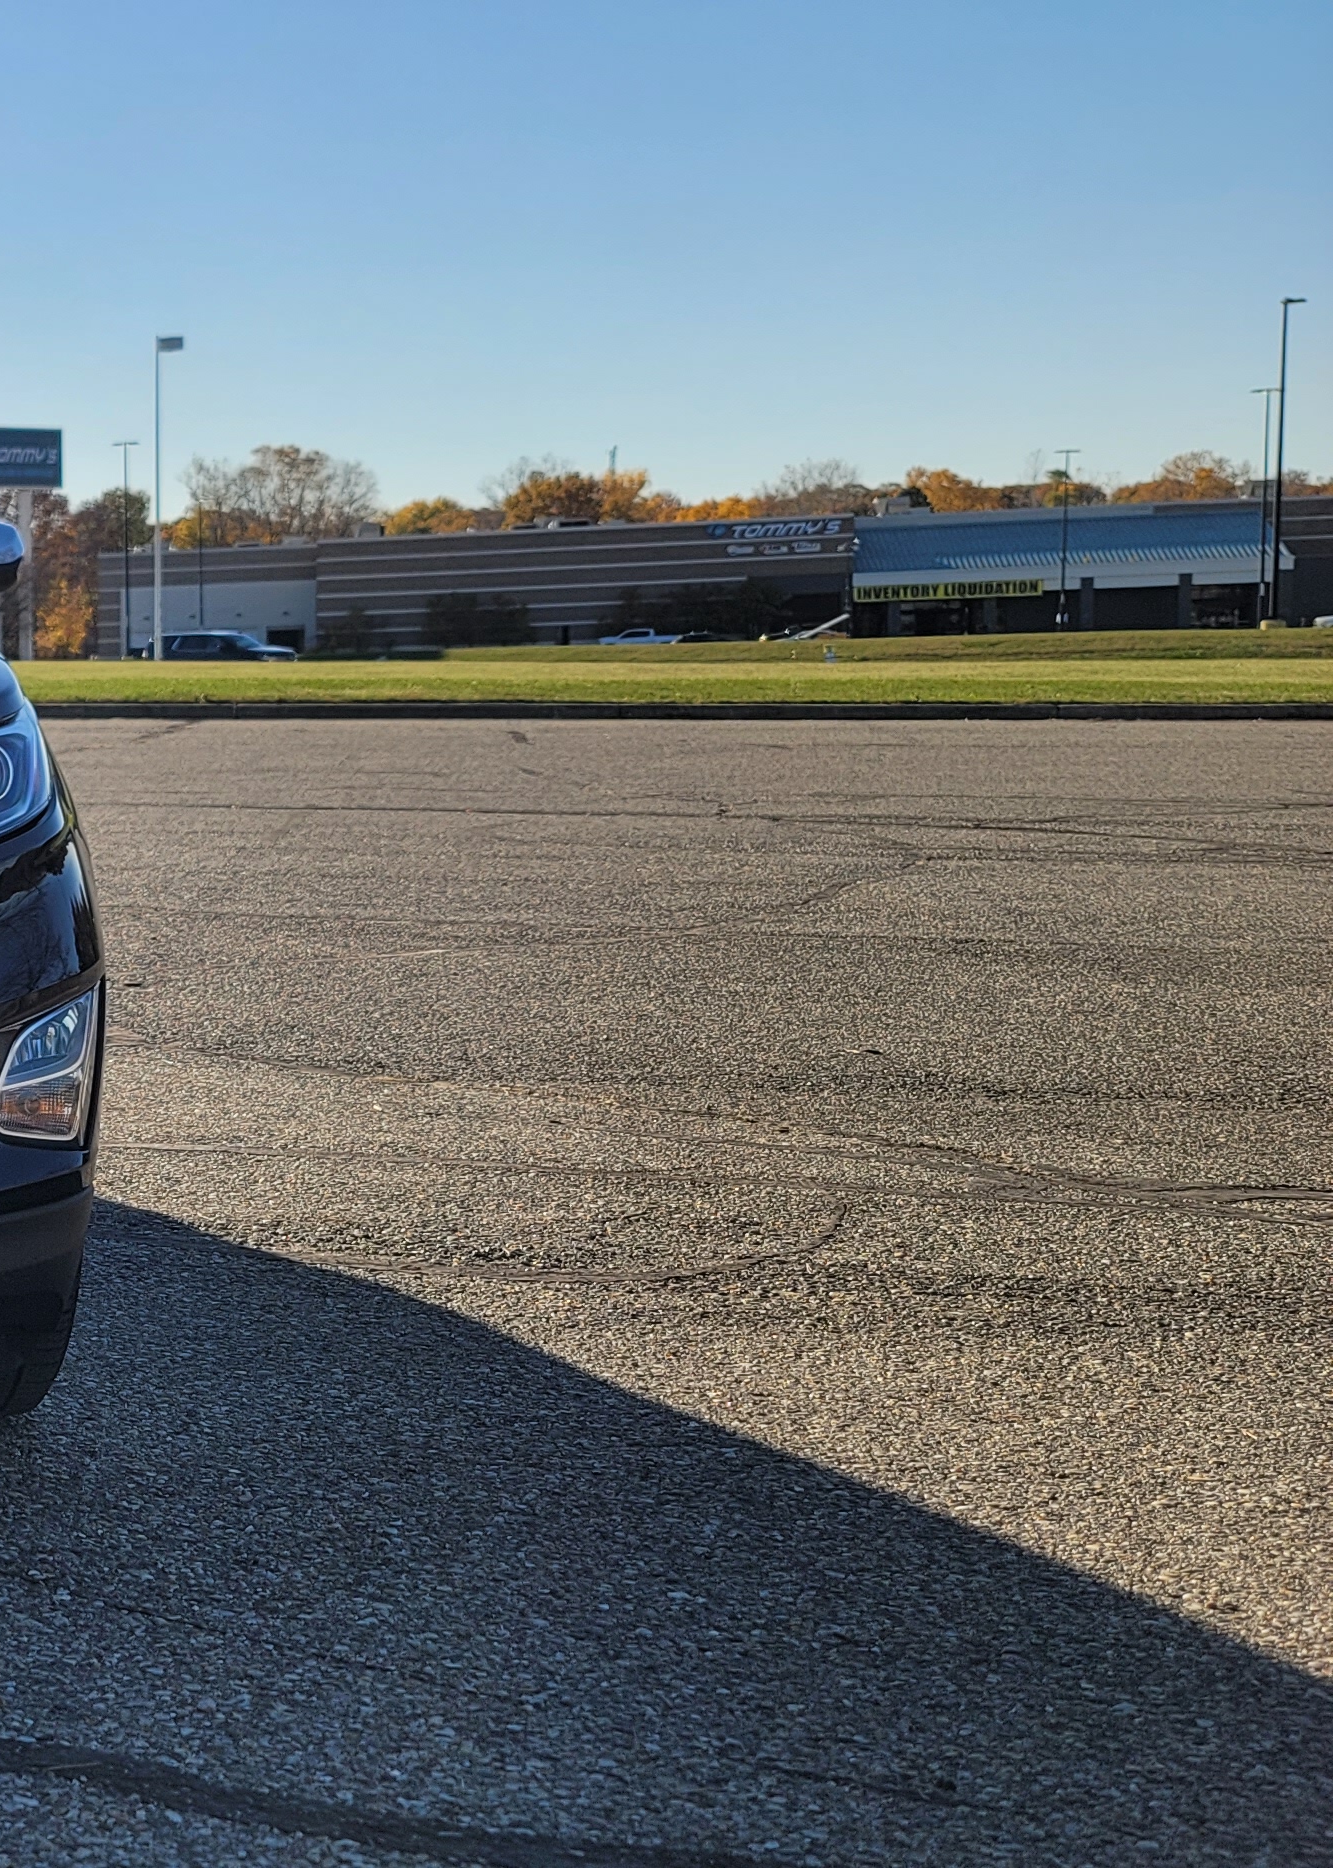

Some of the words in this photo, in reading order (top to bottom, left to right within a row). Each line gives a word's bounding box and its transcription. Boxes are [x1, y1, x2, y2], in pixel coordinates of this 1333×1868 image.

[731, 519, 842, 538] TOMMY'S
[856, 584, 940, 600] INVENTORY
[943, 580, 1039, 597] LIQUIDATION
